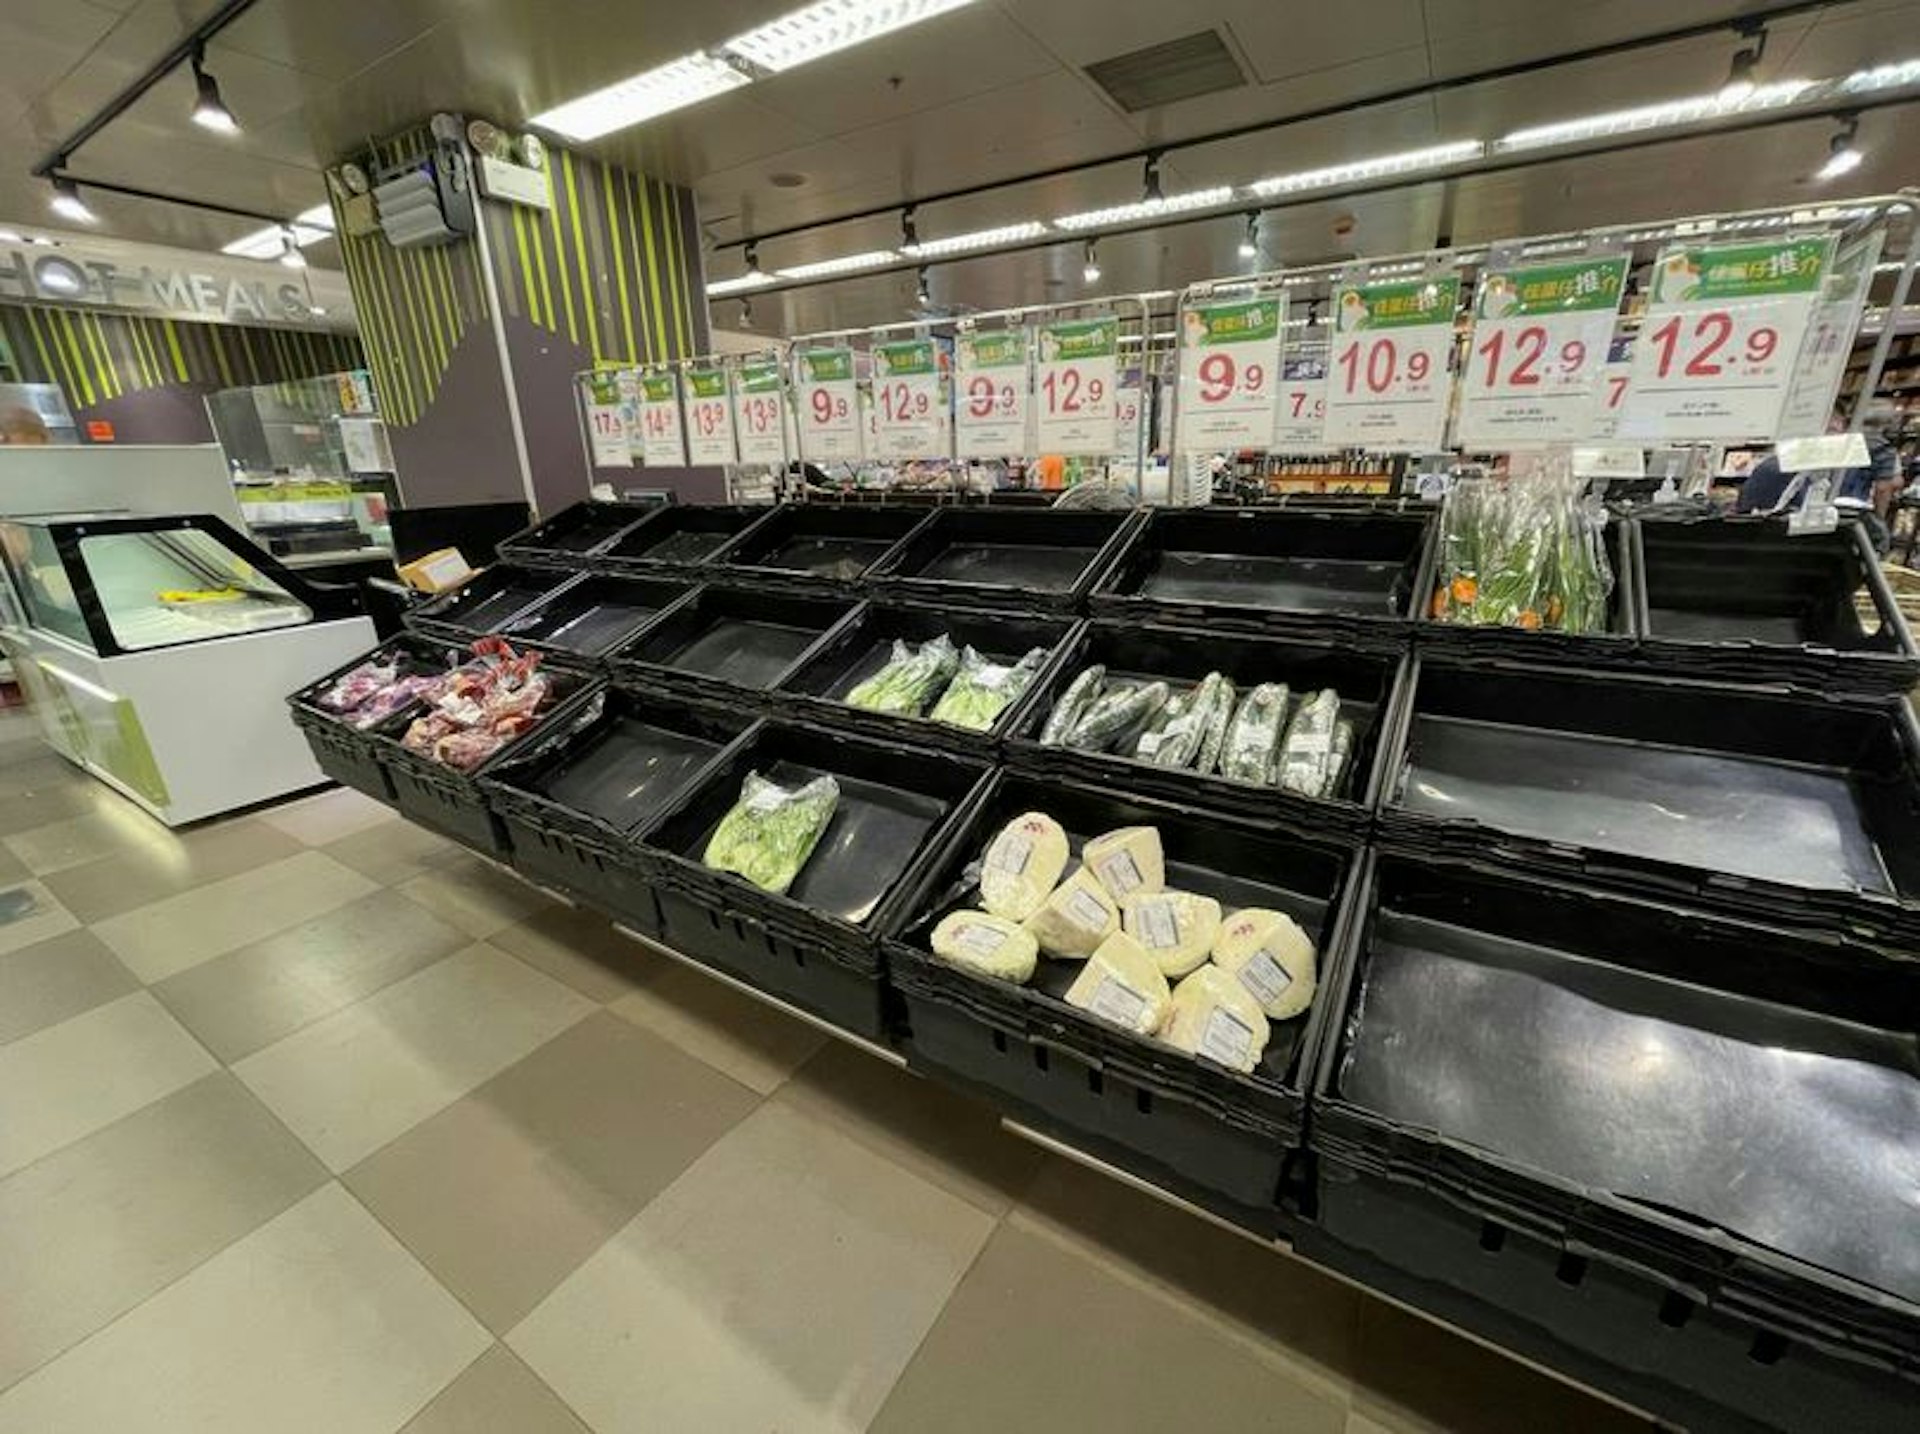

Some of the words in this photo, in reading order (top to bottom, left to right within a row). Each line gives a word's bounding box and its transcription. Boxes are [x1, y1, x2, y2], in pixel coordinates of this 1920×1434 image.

[142, 266, 301, 321] MEALS
[1339, 338, 1430, 394] 10.9
[1479, 326, 1586, 387] 12.9
[1652, 312, 1778, 378] 12.9
[881, 382, 929, 421] 12.9
[1043, 368, 1103, 413] 12.9
[1199, 354, 1263, 403] 9.9
